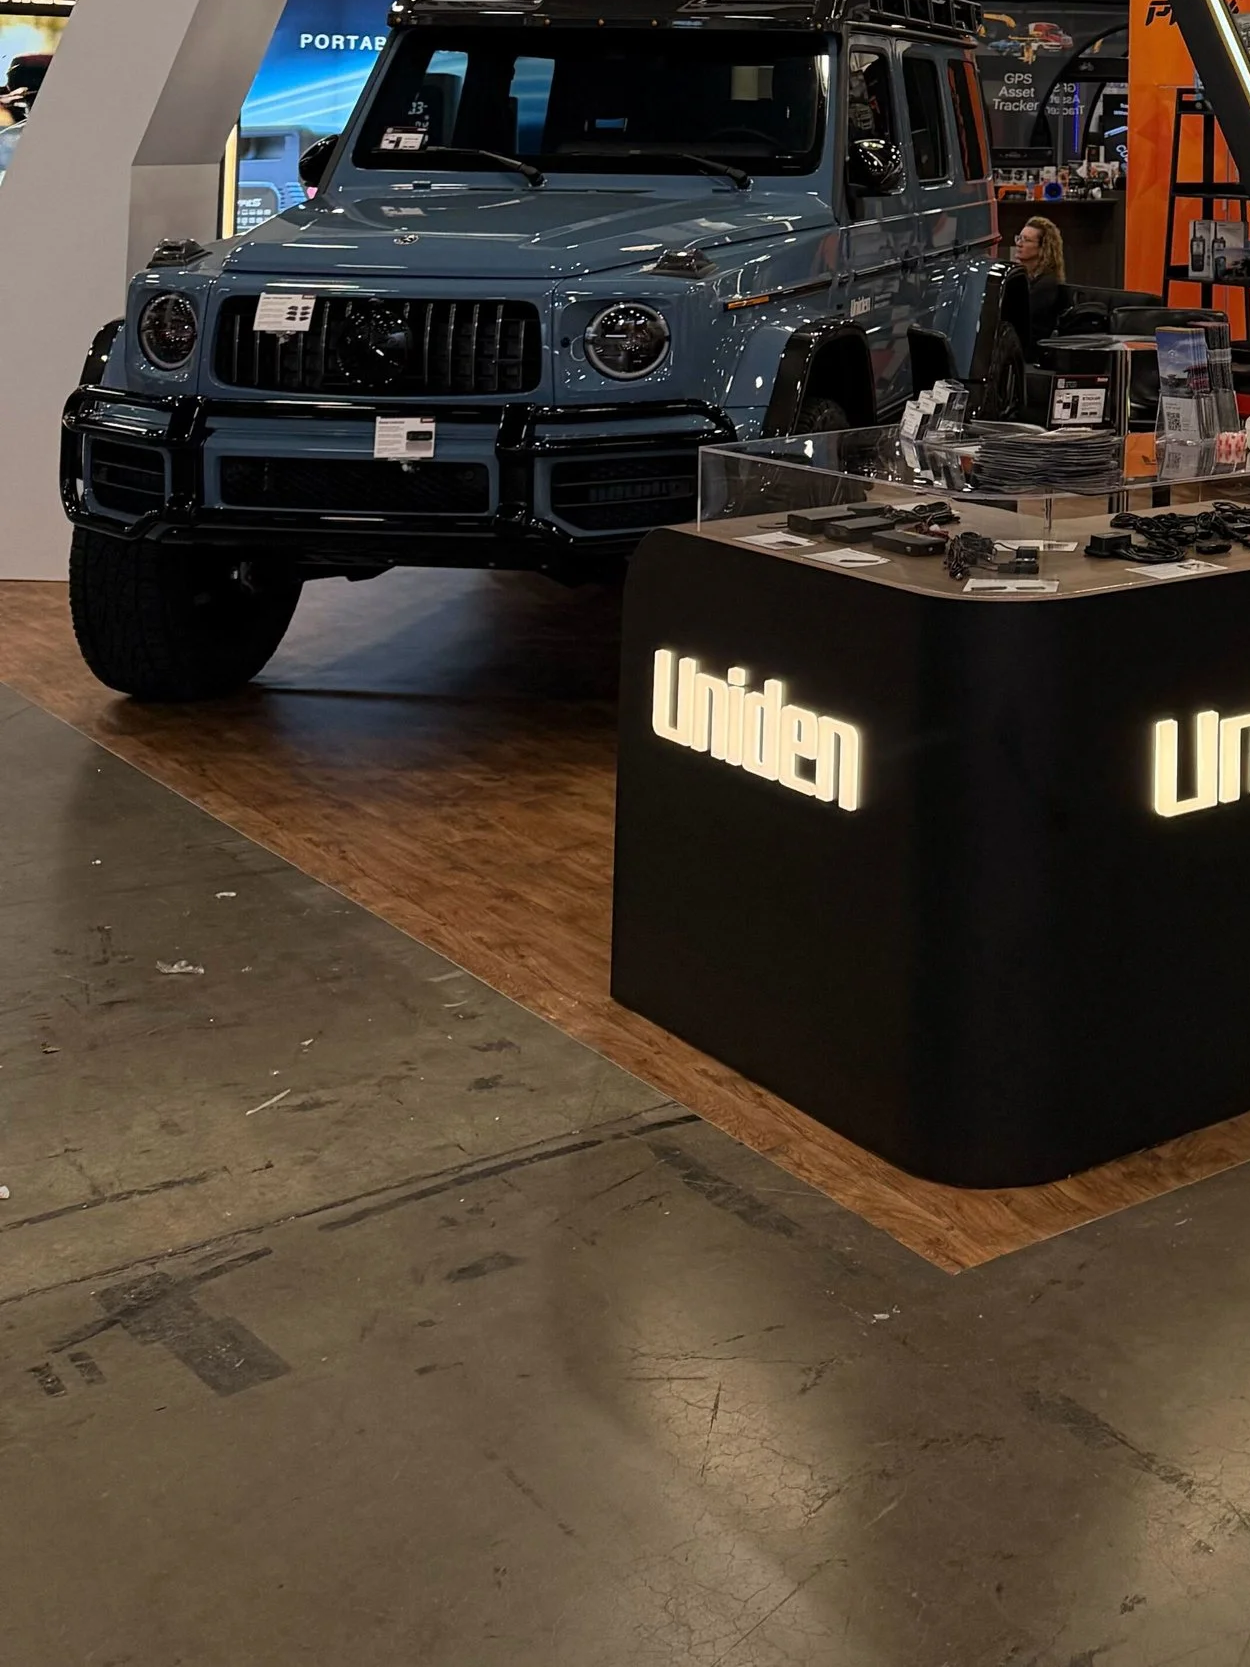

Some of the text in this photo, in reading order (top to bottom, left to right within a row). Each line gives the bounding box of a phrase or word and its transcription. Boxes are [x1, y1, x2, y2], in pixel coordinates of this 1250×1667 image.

[1004, 73, 1033, 85] GPS
[998, 85, 1035, 98] Asset
[992, 98, 1039, 111] Tracker
[653, 648, 861, 812] Uniden
